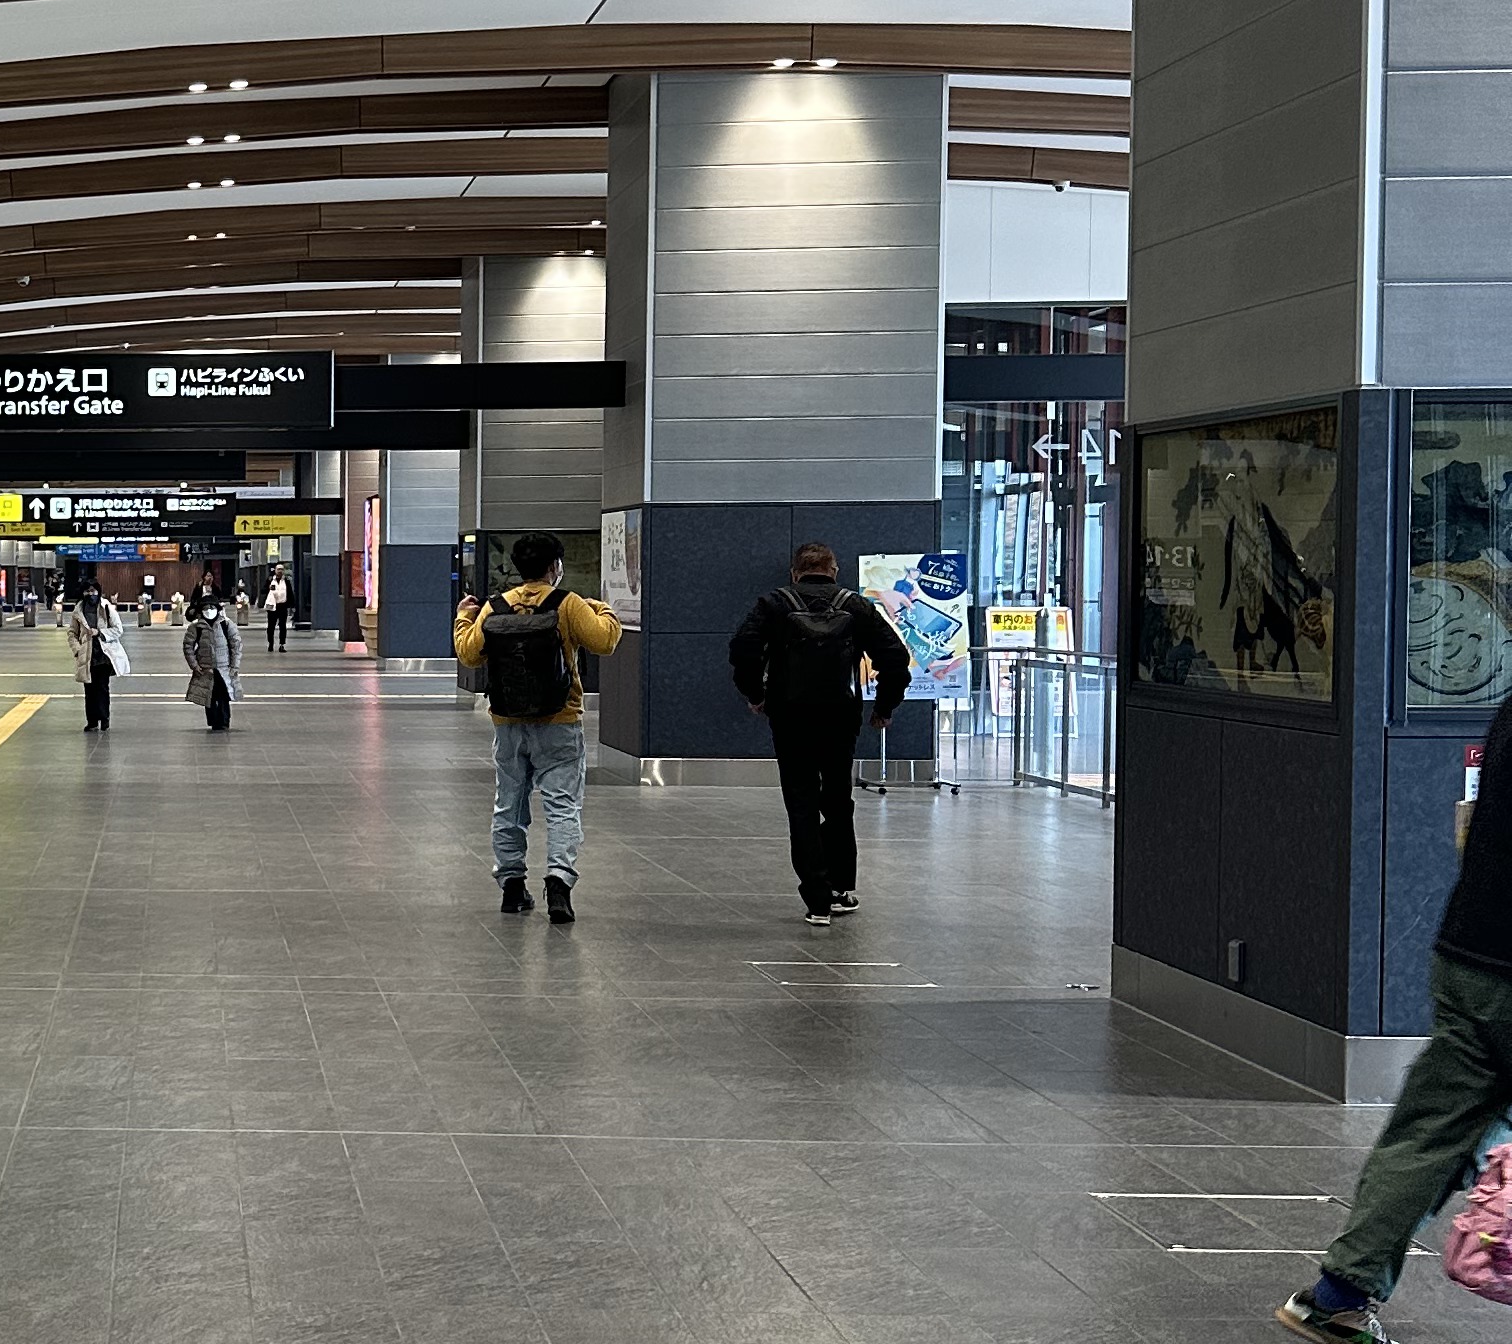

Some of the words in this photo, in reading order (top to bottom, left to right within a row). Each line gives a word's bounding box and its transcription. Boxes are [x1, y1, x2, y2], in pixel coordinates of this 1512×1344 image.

[180, 367, 305, 383] ハピラインふくい
[180, 384, 237, 399] Hapi-Line
[238, 384, 271, 396] Fukui
[73, 396, 124, 415] Gate
